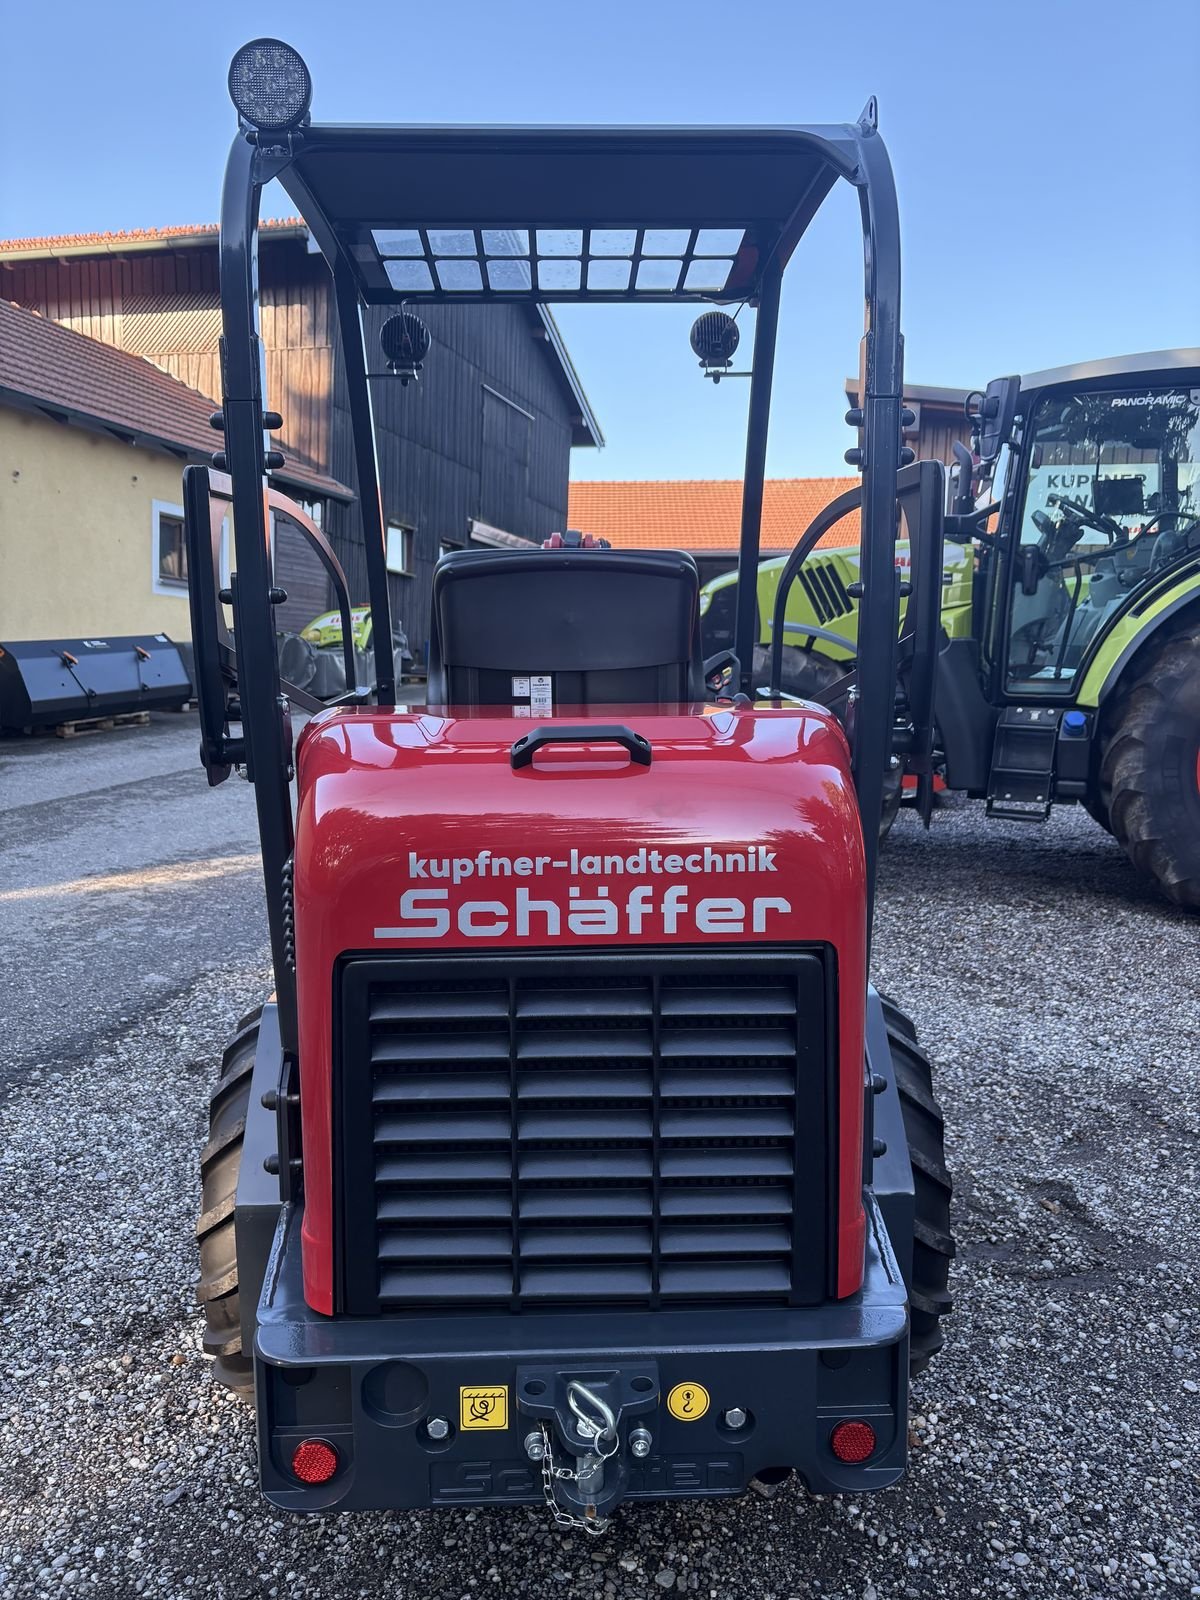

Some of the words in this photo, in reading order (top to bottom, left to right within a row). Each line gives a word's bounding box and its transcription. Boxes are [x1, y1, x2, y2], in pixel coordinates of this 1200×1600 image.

[1111, 395, 1187, 407] PANORAMIC
[408, 846, 778, 884] kupfner-landtechnik
[373, 885, 792, 939] Schäffer
